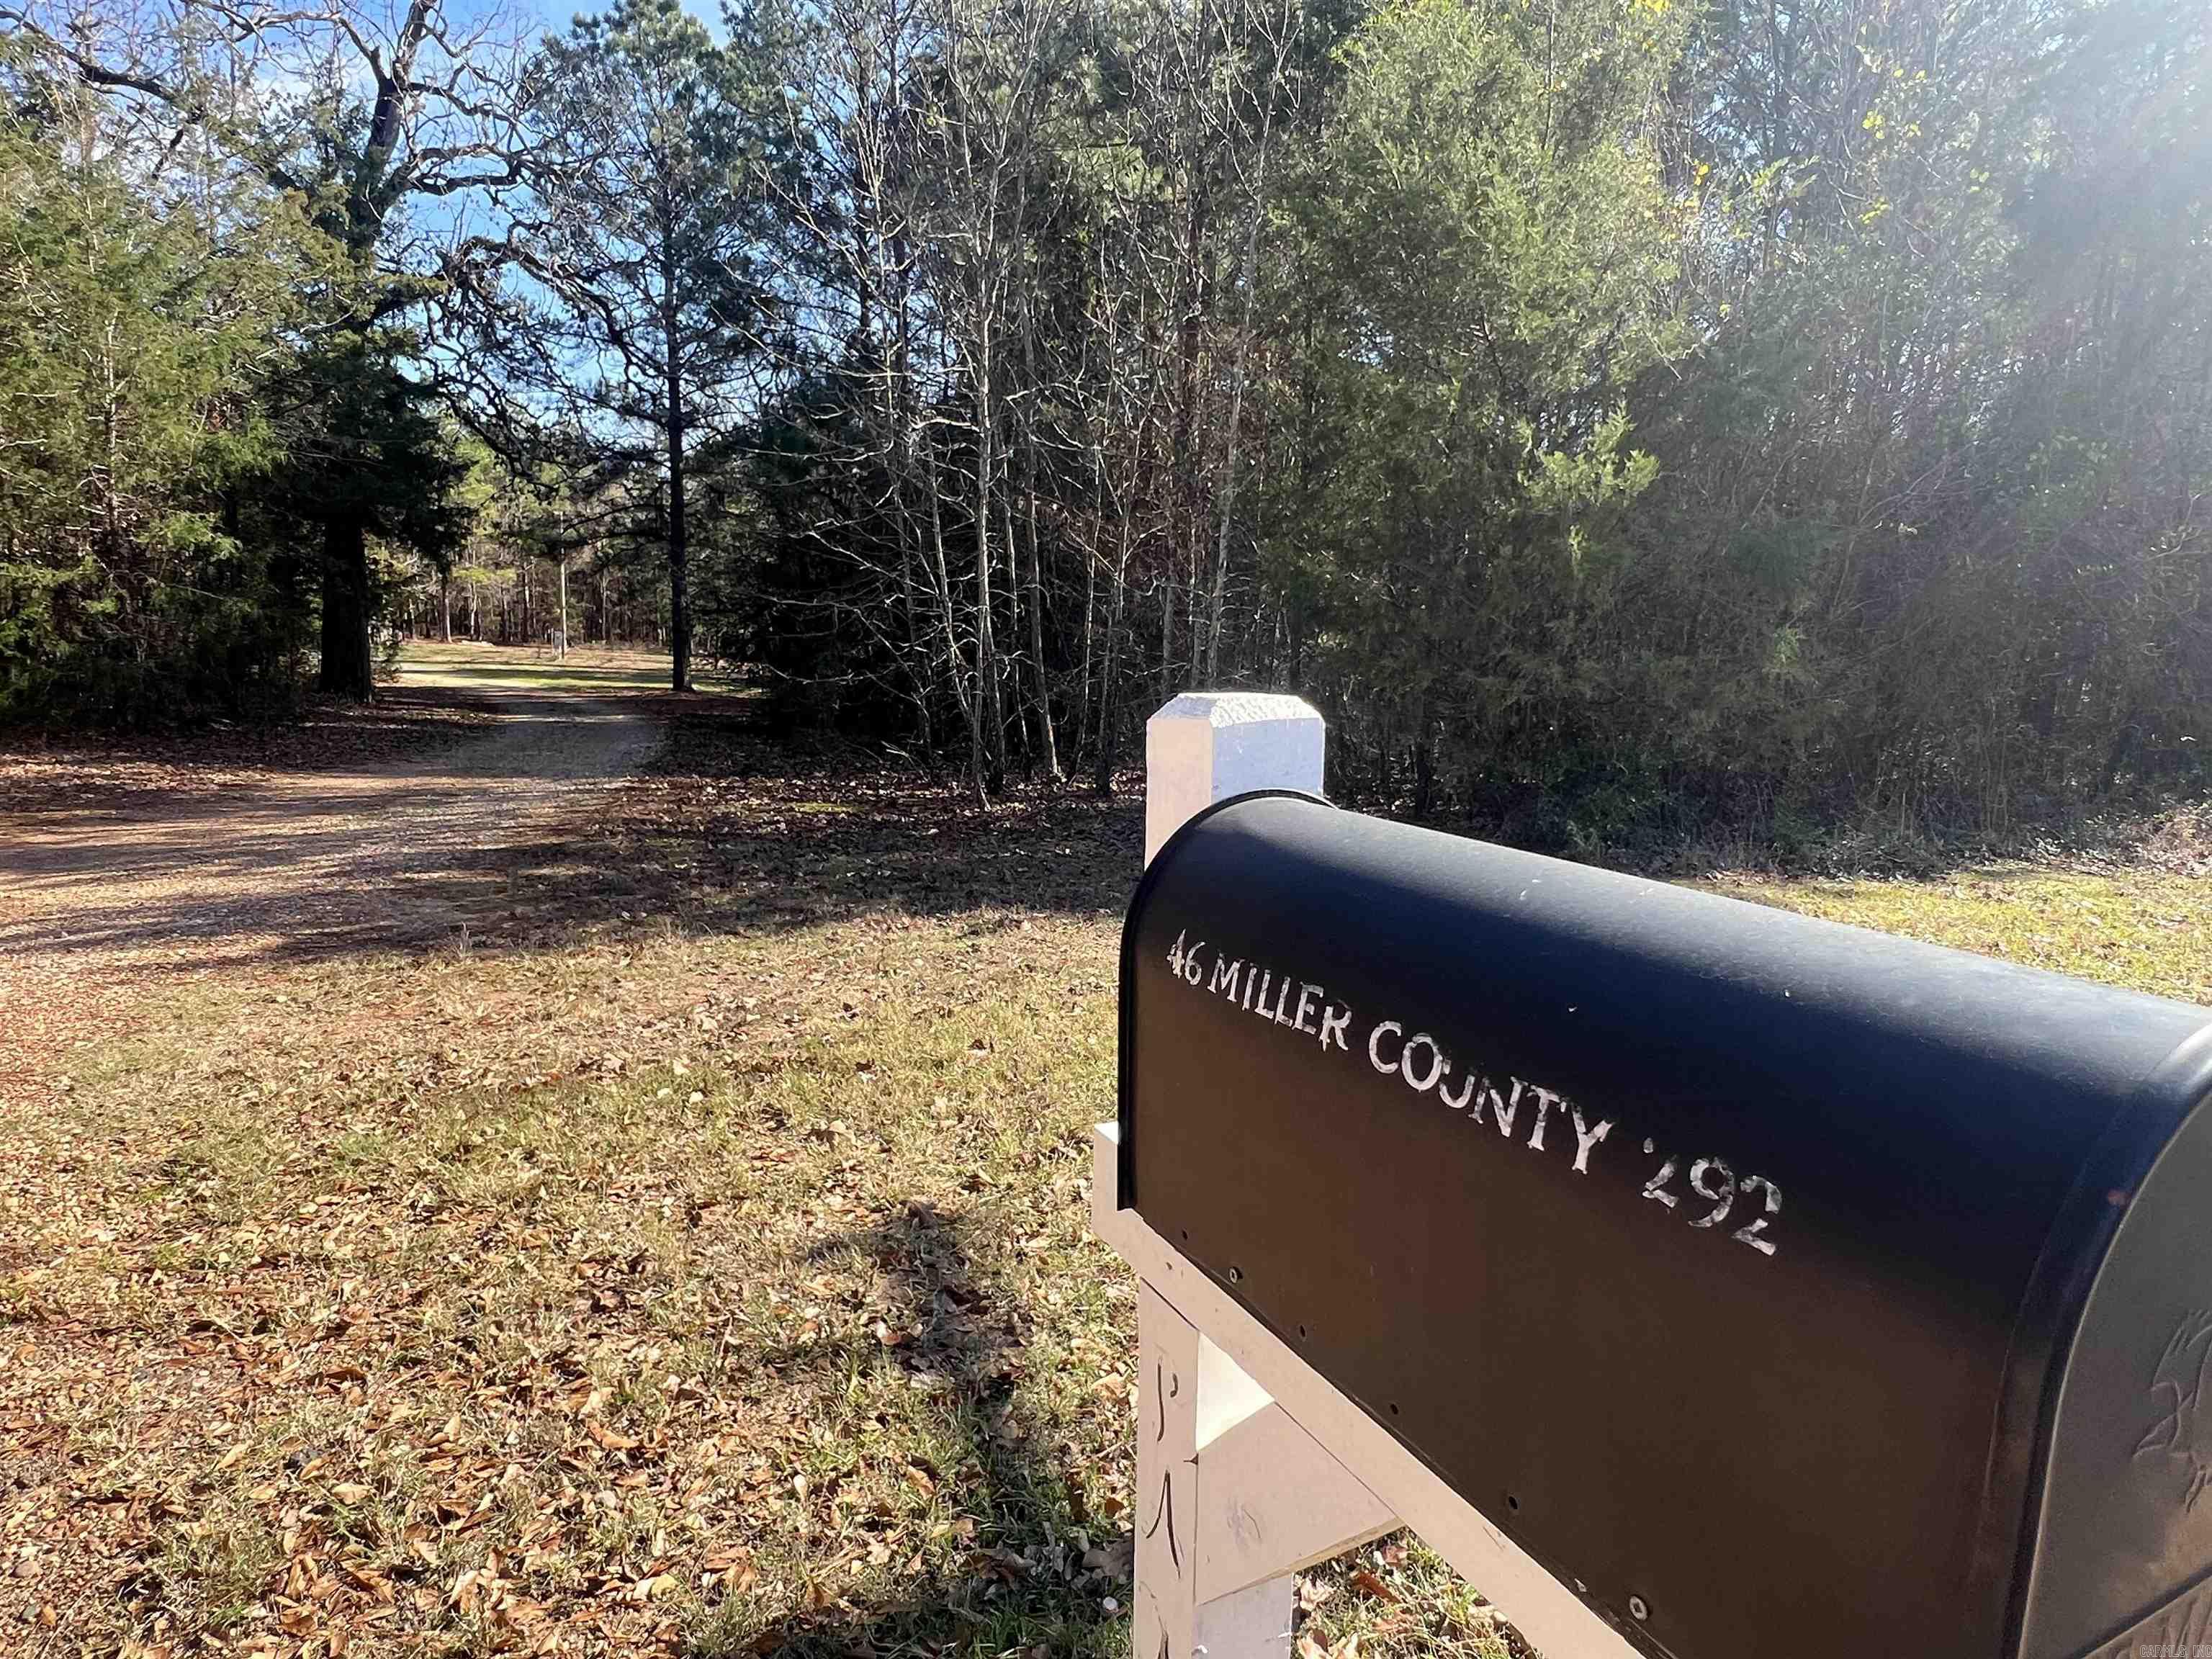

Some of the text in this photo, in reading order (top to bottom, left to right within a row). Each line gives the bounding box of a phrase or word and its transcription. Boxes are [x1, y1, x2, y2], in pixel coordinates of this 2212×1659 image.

[1166, 928, 1206, 986] 46
[1207, 949, 1353, 1052] MILLER
[1368, 1020, 1615, 1175] COUNTY
